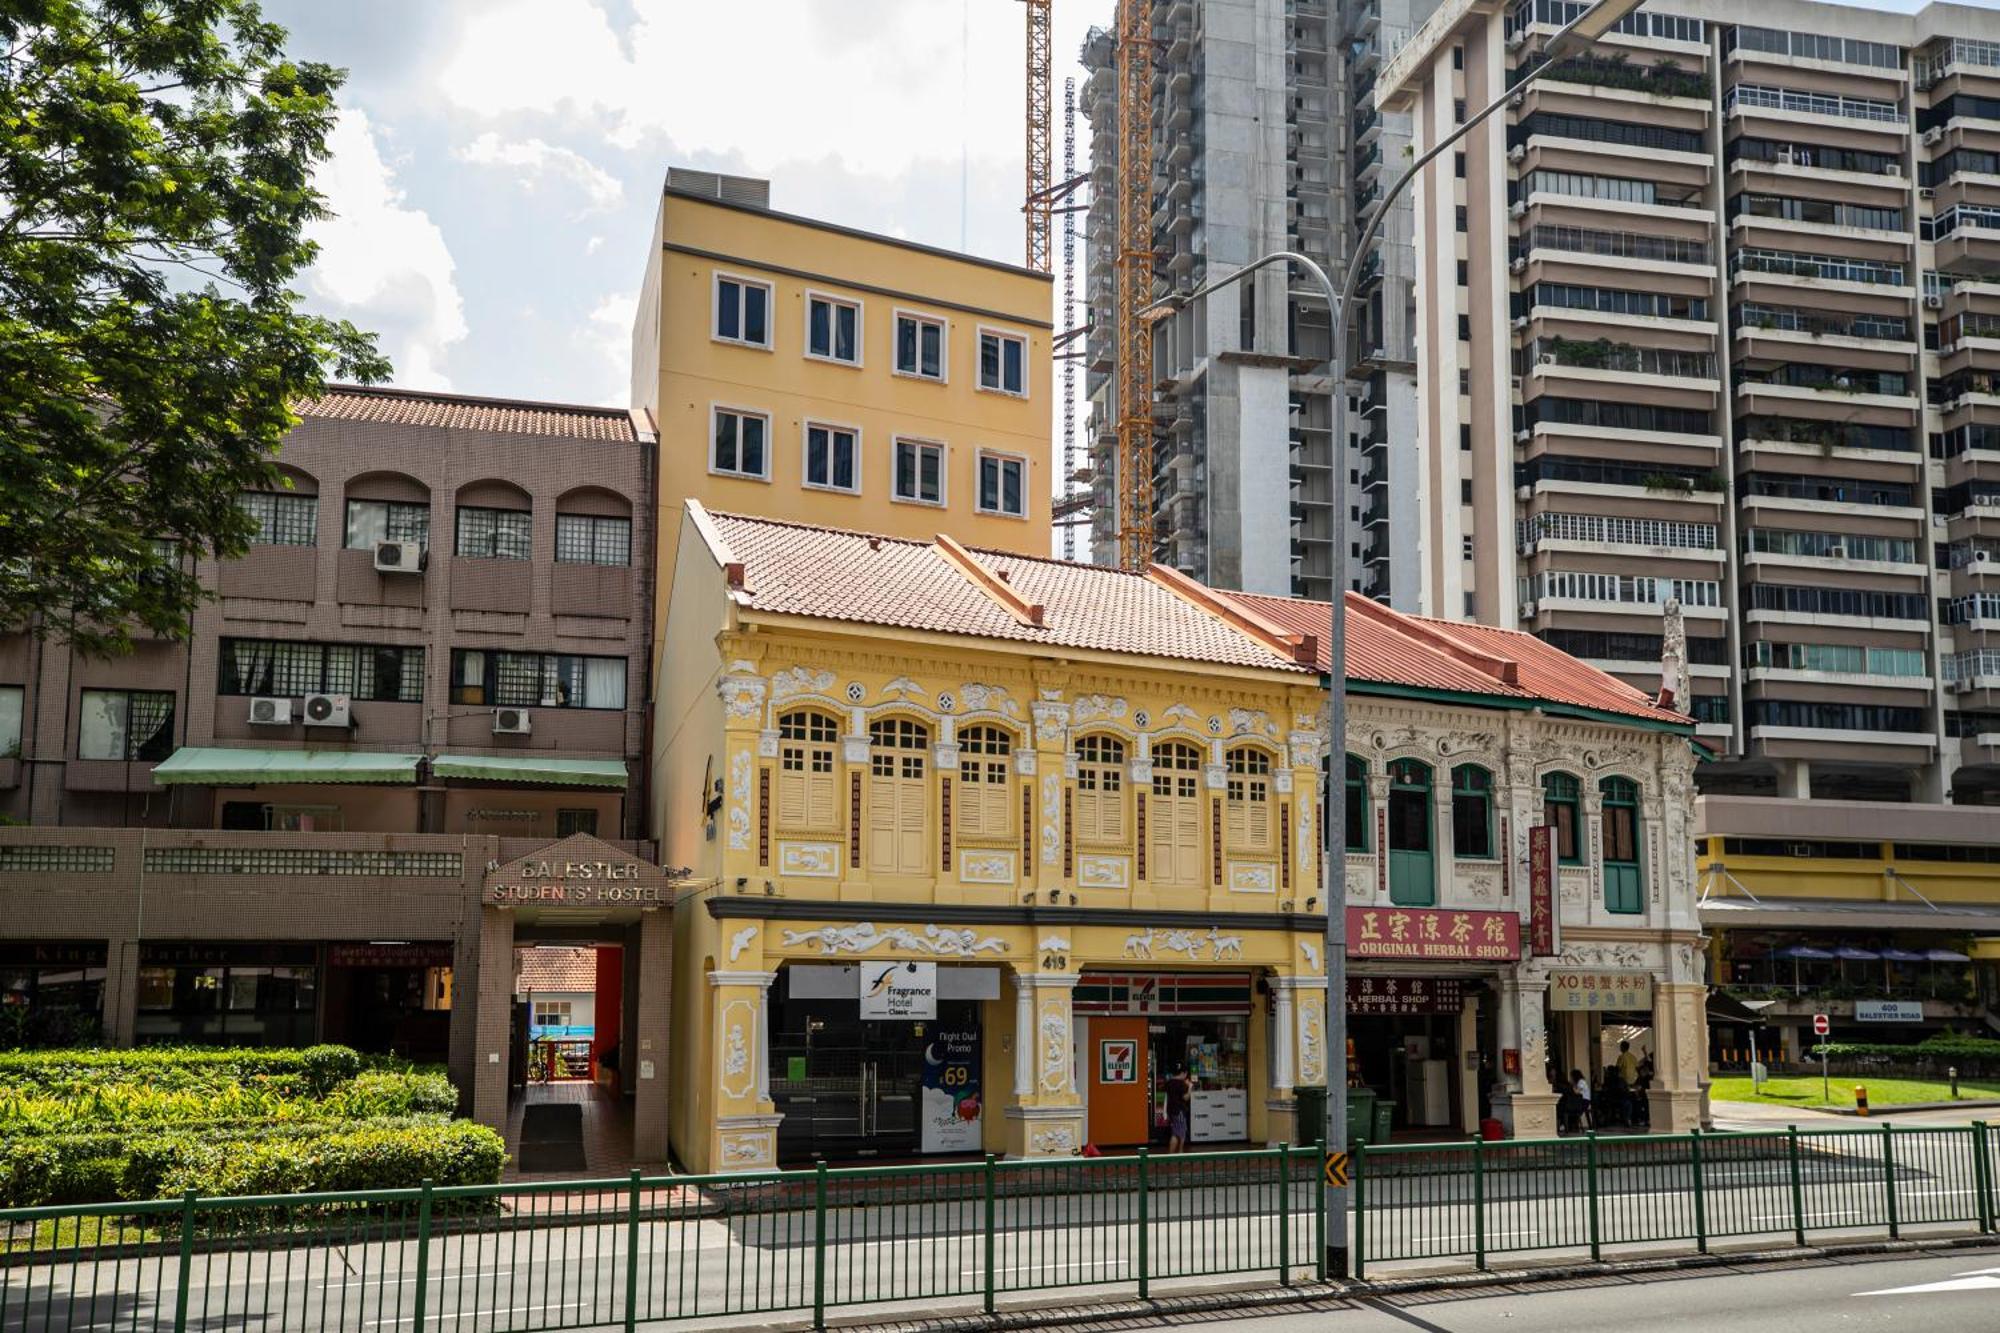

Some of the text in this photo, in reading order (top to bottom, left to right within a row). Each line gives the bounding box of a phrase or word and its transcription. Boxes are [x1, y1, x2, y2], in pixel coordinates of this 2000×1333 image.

[522, 861, 638, 880] BALESTIER
[598, 887, 661, 901] HOSTEL
[1359, 943, 1509, 958] ORIGINAL HERBAL SHOP
[887, 986, 931, 998] Fragrance
[887, 997, 913, 1007] Hotel
[1357, 995, 1399, 1003] HERBAL
[1401, 995, 1430, 1003] SHOP
[947, 1043, 972, 1053] Promo
